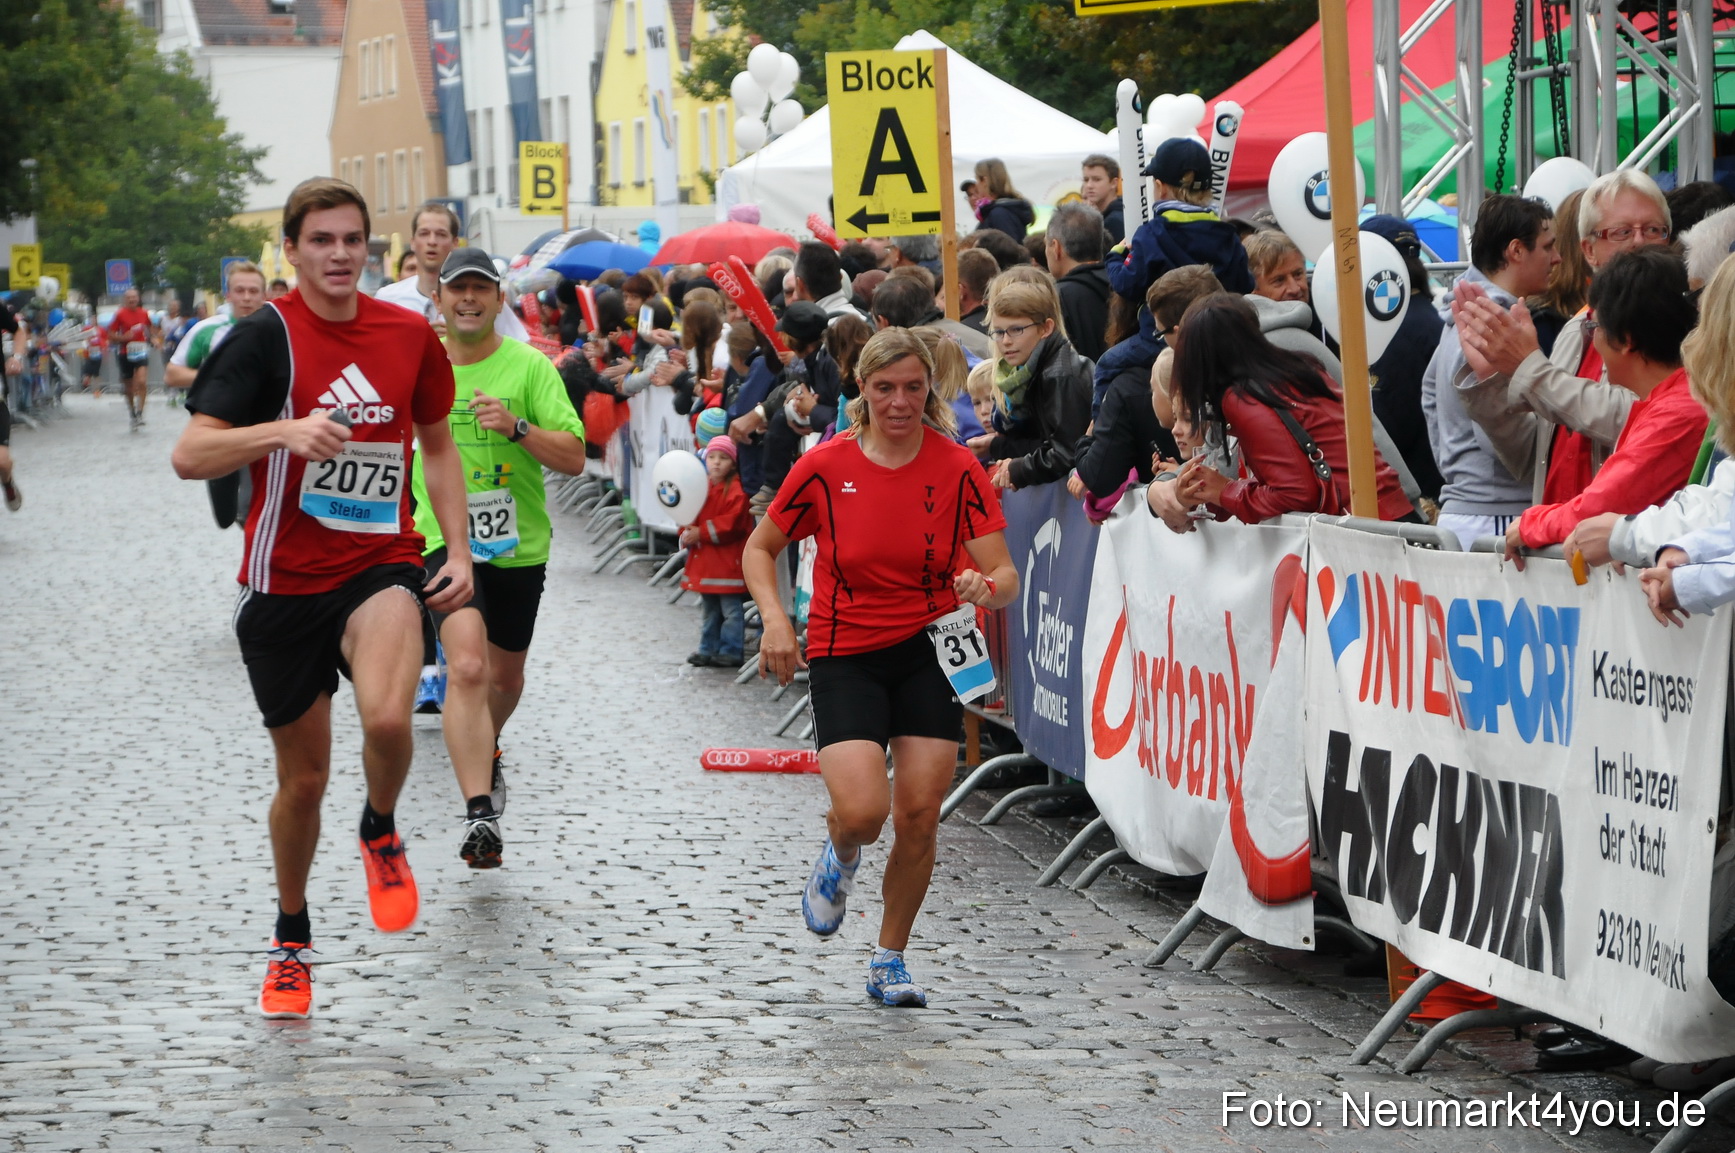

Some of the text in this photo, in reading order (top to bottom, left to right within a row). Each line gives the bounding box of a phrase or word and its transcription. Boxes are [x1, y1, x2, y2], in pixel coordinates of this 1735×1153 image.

[841, 57, 934, 92] Block
[526, 144, 562, 158] Block
[859, 107, 928, 196] A
[533, 164, 556, 198] B
[1307, 170, 1330, 190] BM
[17, 256, 32, 277] C
[1368, 270, 1404, 291] BMW
[349, 449, 397, 460] Neumarkt
[313, 458, 400, 497] 2075
[329, 501, 371, 519] Stefan
[468, 498, 502, 508] eumarkt
[1593, 649, 1697, 723] Kastengass
[1595, 746, 1678, 813] Im Herzen
[1600, 812, 1667, 878] der Stadt
[1597, 908, 1686, 992] 92318 Nekt
